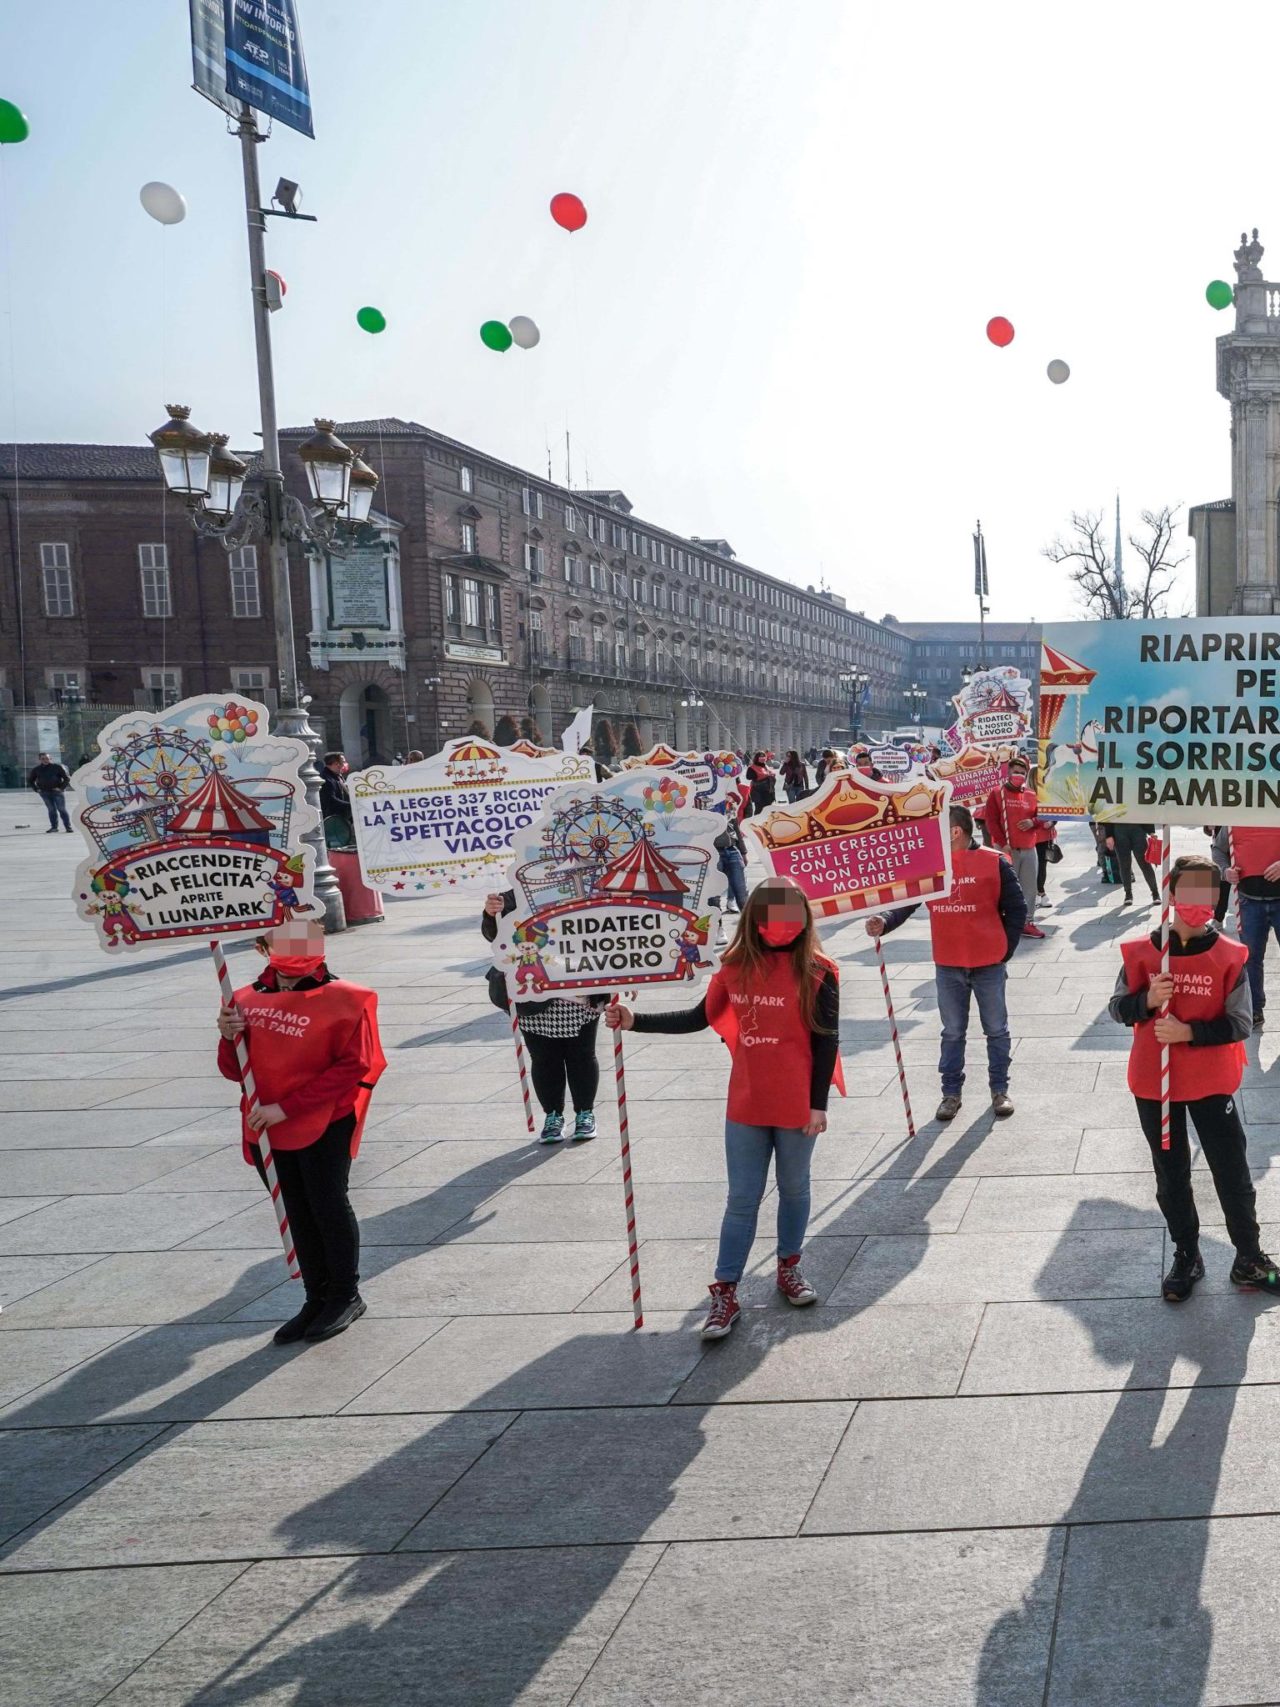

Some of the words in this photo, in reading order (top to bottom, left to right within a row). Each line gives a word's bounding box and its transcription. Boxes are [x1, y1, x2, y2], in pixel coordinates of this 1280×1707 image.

[978, 714, 1012, 723] RIDATECI
[985, 721, 1014, 730] NOSTRO
[980, 728, 1012, 736] LAVORO
[1097, 741, 1123, 770] IL
[953, 774, 996, 788] IVERTIMENTO
[956, 766, 1000, 782] LUNAPARK
[1089, 776, 1123, 804] AI
[373, 800, 394, 812] LA
[400, 796, 452, 810] LEGGE
[458, 792, 487, 805] 337
[364, 815, 386, 827] LA
[392, 806, 479, 824] FUNZIONE
[485, 800, 544, 815] SOCIAL
[390, 814, 532, 842] SPETTACOLO
[790, 844, 832, 862] SIETE
[839, 826, 919, 852] CRESCIUTI
[790, 859, 826, 875] CON
[834, 854, 850, 866] LE
[857, 838, 925, 861] GIOSTRE
[135, 854, 262, 880] RIACCENDETE
[812, 868, 850, 884] NON
[858, 854, 910, 874] FATELE
[139, 882, 167, 901] LA
[833, 870, 896, 893] MORIRE
[180, 892, 224, 904] APRITE
[932, 904, 976, 912] PIEMONTE
[147, 912, 154, 926] I
[159, 901, 266, 924] LUNAPARK
[562, 914, 661, 936] RIDATECI
[560, 940, 575, 954] IL
[582, 934, 666, 953] NOSTRO
[565, 951, 663, 973] LAVORO
[728, 994, 750, 1004] UNA
[753, 995, 785, 1006] PARK
[1183, 986, 1212, 996] PARK
[242, 1008, 310, 1026] APRIAMO
[268, 1021, 306, 1038] PARK
